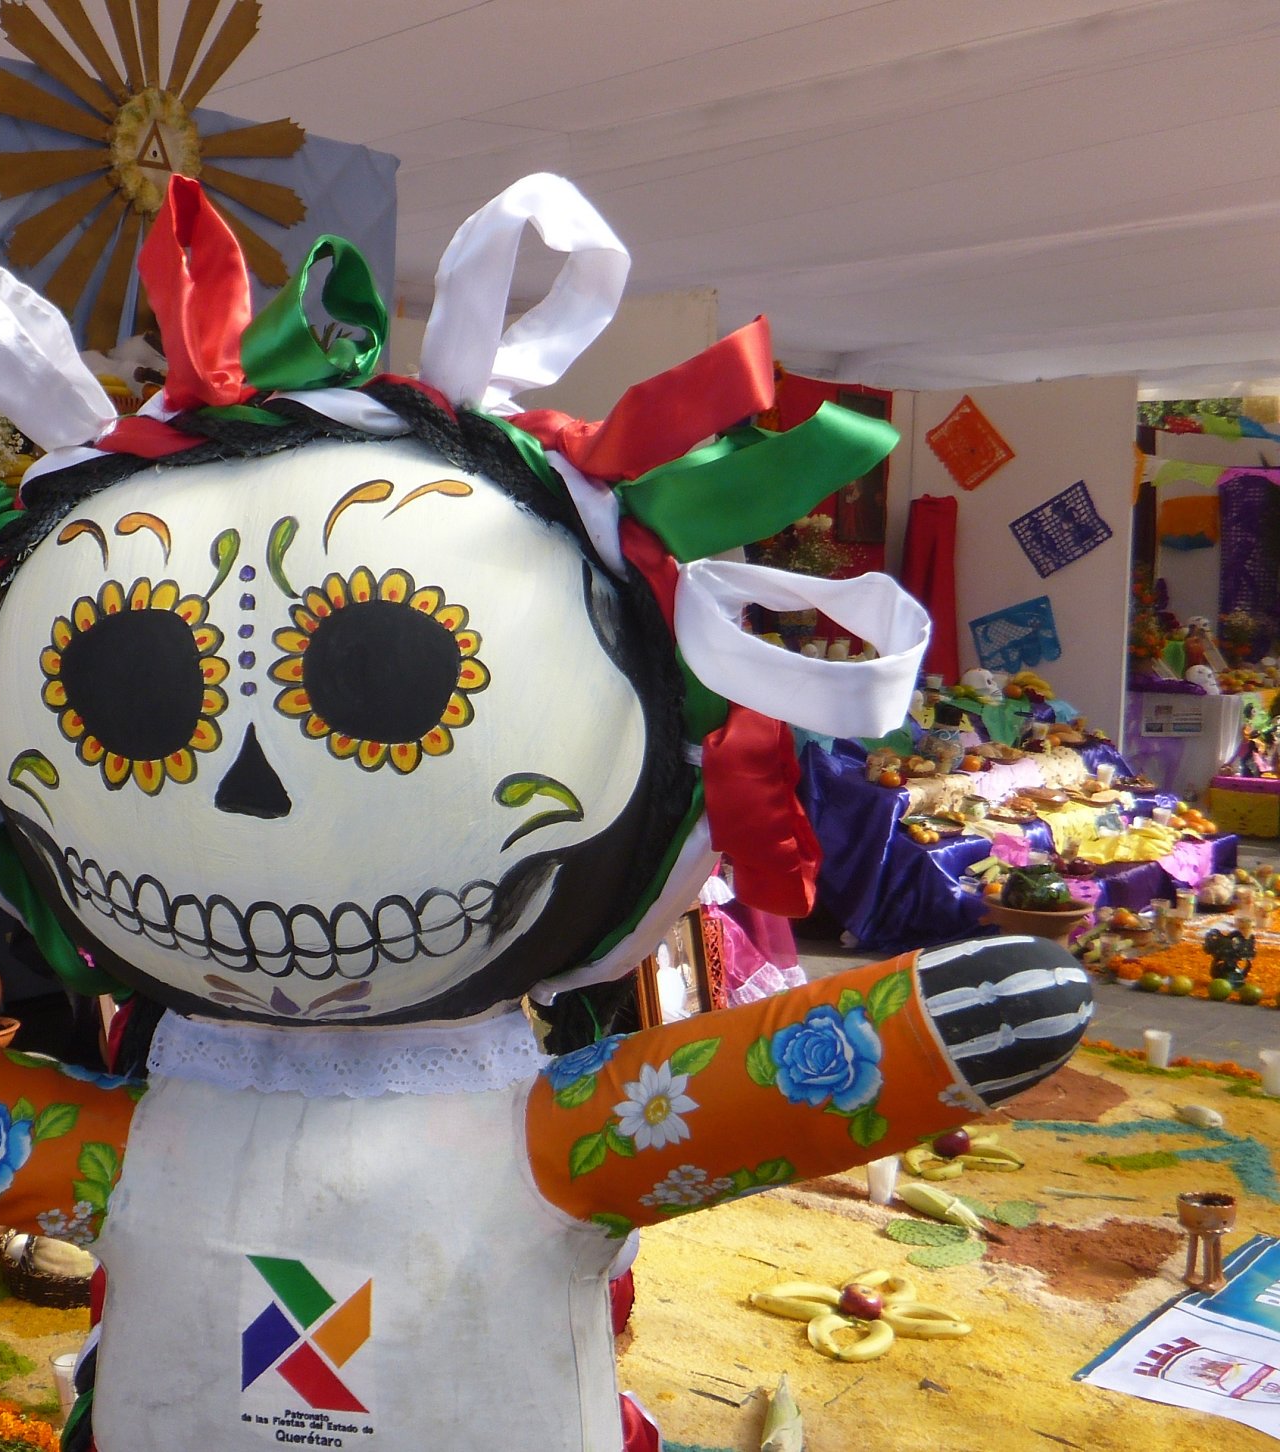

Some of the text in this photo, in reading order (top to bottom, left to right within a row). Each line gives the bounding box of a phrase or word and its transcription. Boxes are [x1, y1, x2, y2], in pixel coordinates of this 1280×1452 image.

[241, 1413, 374, 1435] de las Fiestas del Estado de
[285, 1409, 329, 1422] Patronato
[275, 1429, 342, 1447] Querétaro
